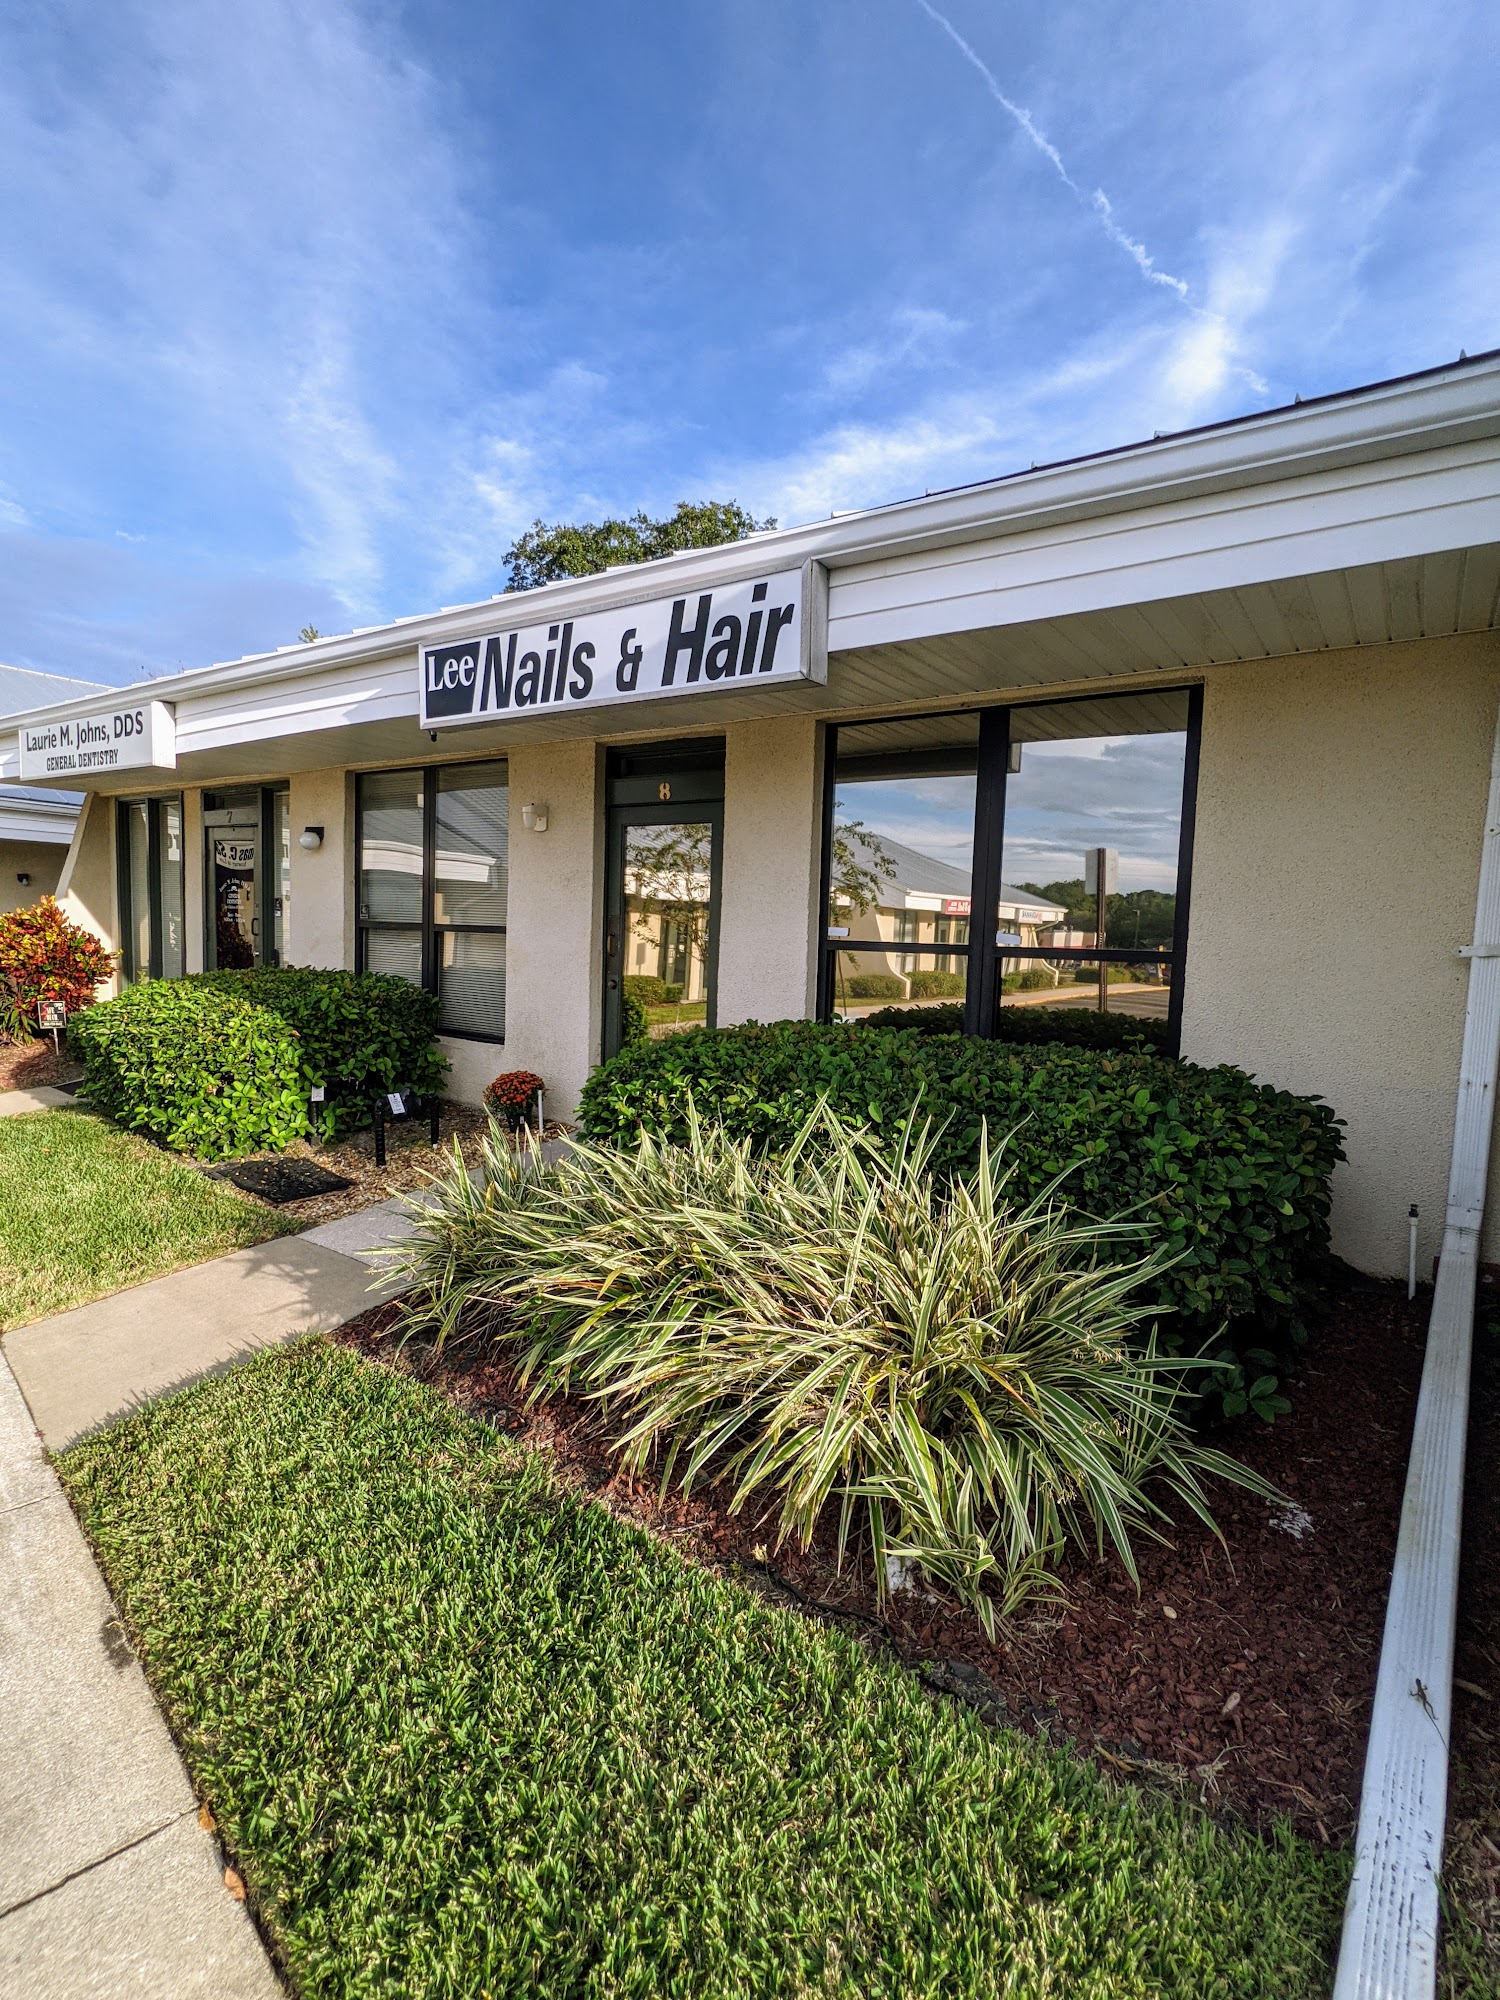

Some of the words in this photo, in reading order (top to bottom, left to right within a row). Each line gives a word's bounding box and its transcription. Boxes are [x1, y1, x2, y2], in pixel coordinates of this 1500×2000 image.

[427, 655, 475, 692] Lee
[480, 622, 596, 712] Nails
[616, 628, 643, 692] &
[661, 582, 795, 687] Hair
[26, 727, 57, 752] Laurie
[60, 724, 73, 747] M.
[76, 720, 110, 750] Johns,
[113, 710, 144, 739] DDS
[46, 754, 77, 772] GENERAL
[78, 748, 119, 768] DENTISTRY
[659, 782, 671, 800] 8
[226, 811, 233, 823] 7
